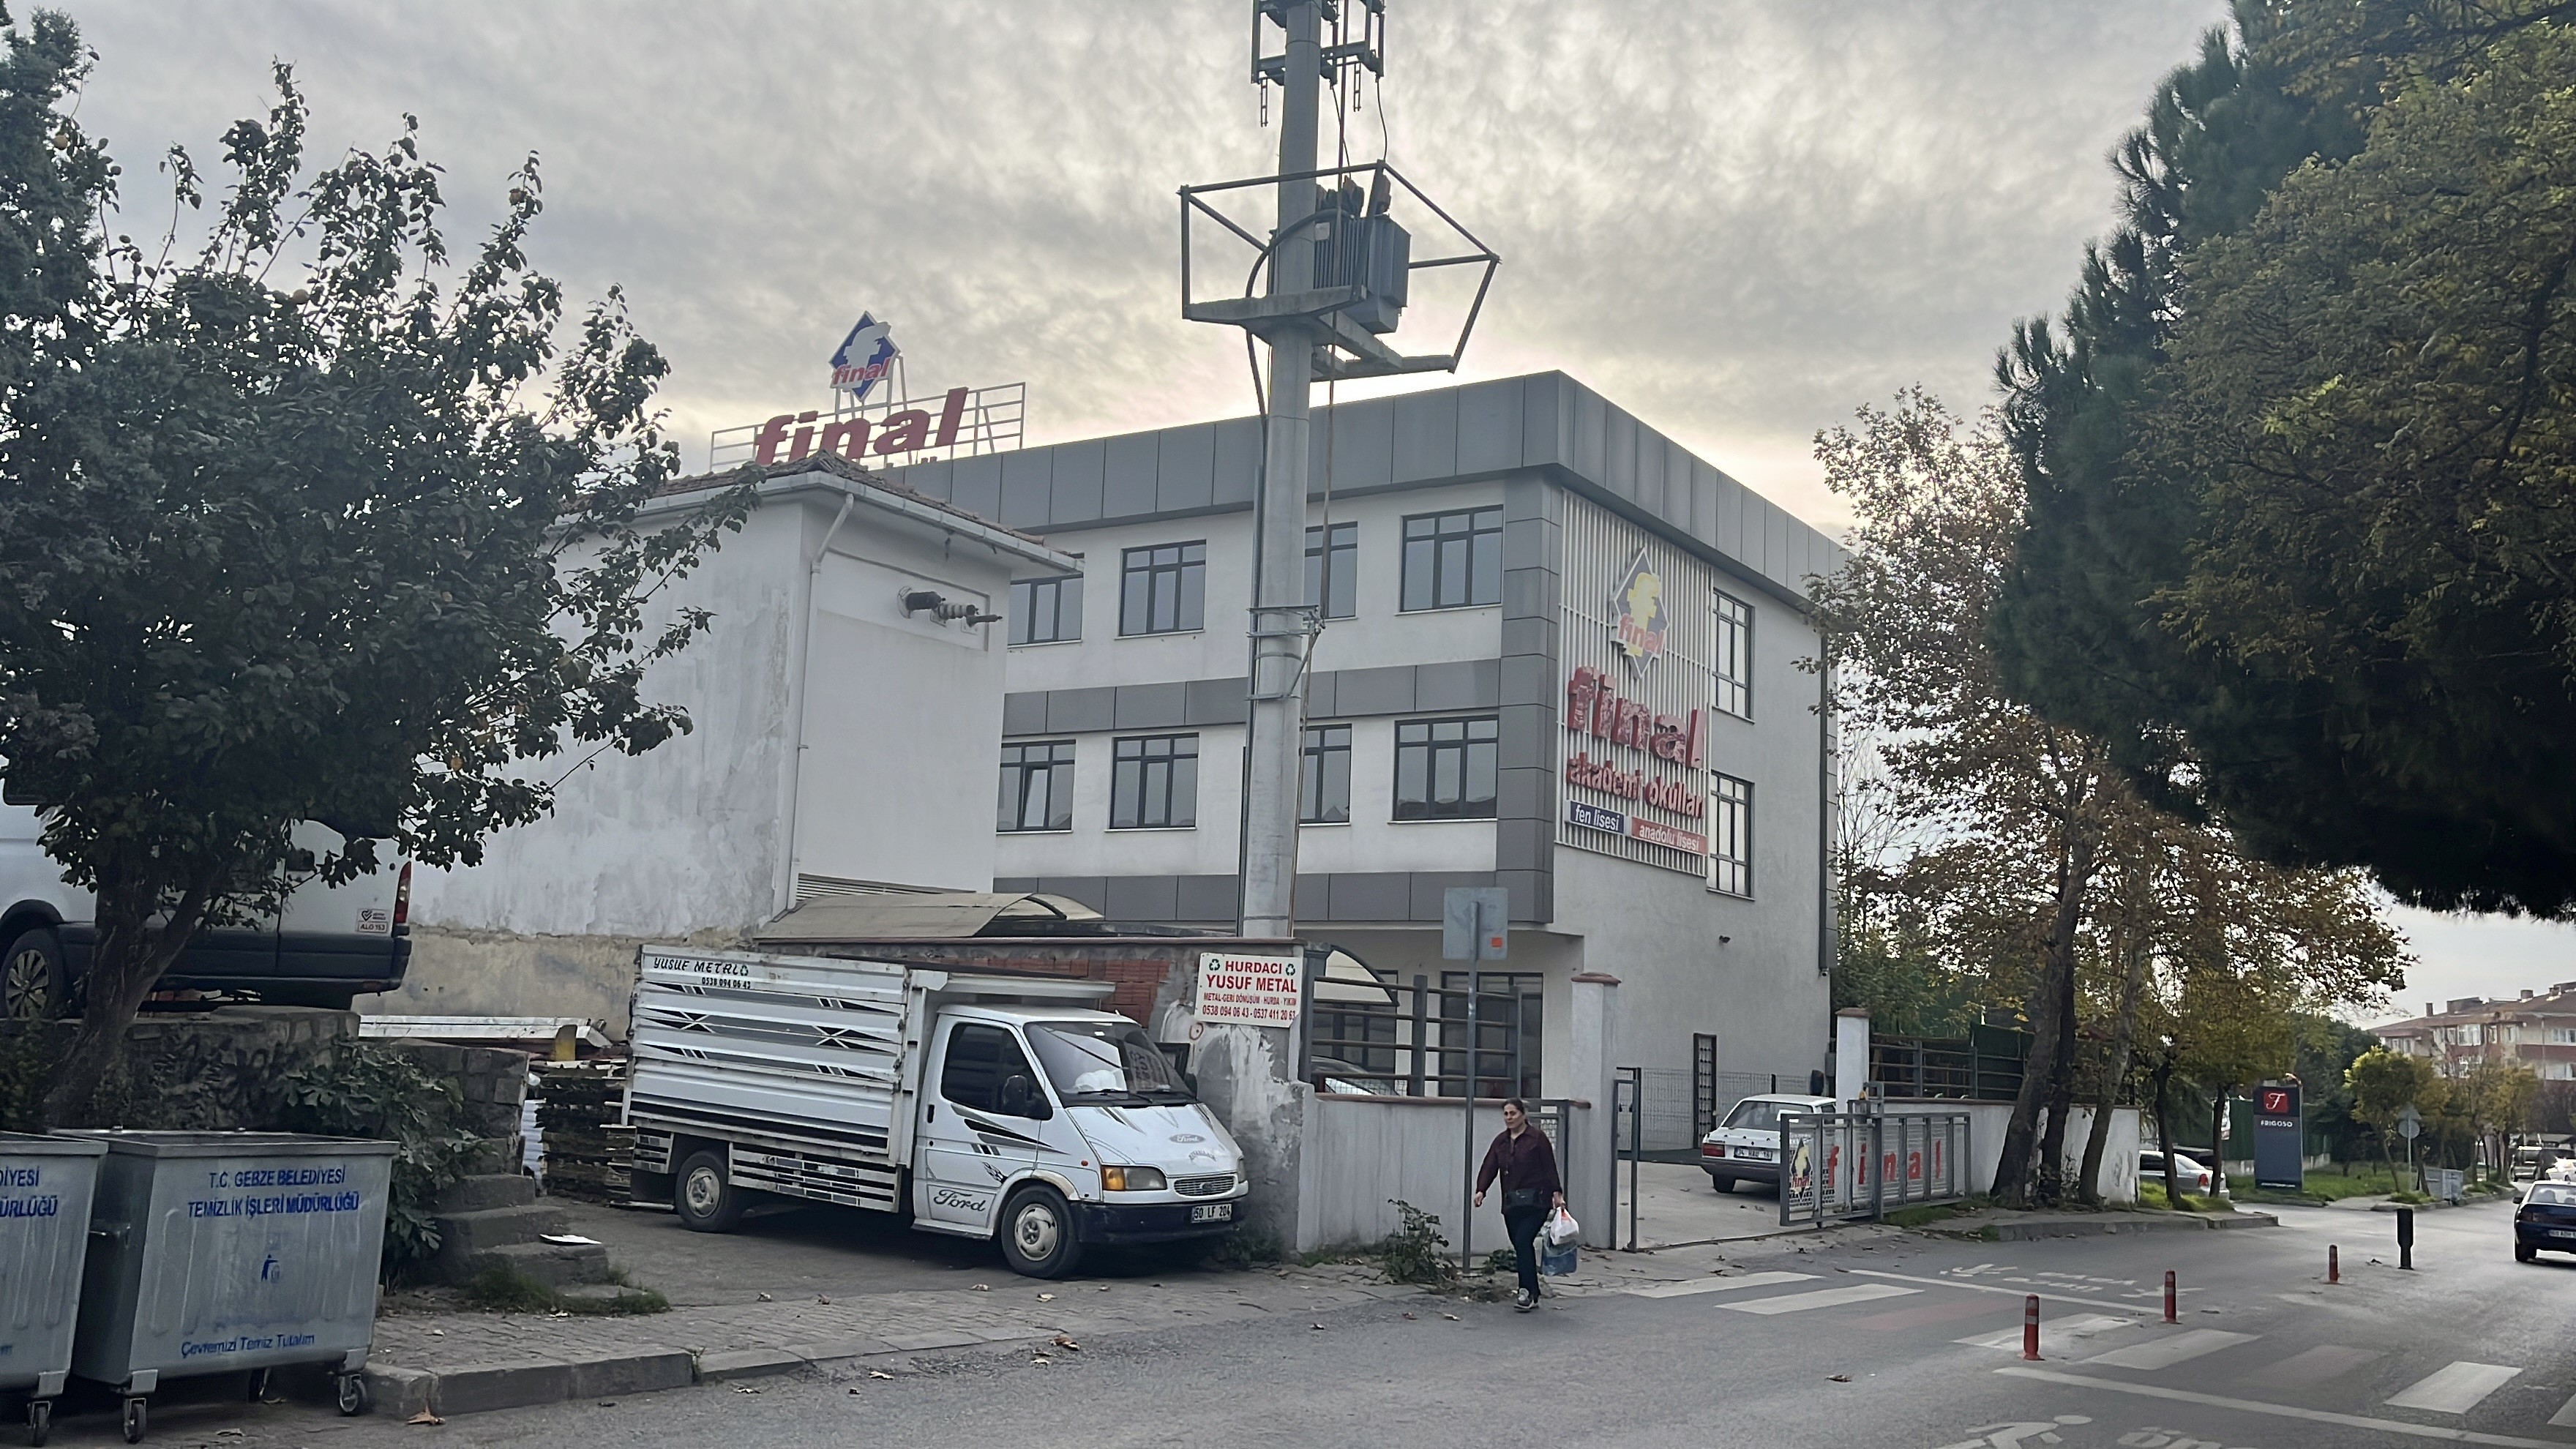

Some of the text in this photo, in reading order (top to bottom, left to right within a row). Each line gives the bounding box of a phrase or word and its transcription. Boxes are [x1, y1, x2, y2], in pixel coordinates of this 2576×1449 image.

[832, 357, 891, 385] final
[755, 386, 969, 465] final
[1618, 613, 1665, 655] final
[1568, 666, 1707, 768] final
[1566, 752, 1643, 800] akademi
[1576, 805, 1620, 831] fen lisesi
[1639, 824, 1699, 852] anadolu lisesi
[654, 957, 689, 970] YUSUF
[1225, 961, 1282, 974] HURDACI
[702, 977, 750, 989] 0538 094 06 43
[1207, 974, 1297, 992] YUSUF METAL
[1202, 1005, 1218, 1015] 0538
[1220, 1006, 1231, 1016] 094
[1233, 1007, 1240, 1016] 06
[1242, 1008, 1248, 1017] 43
[1253, 1008, 1268, 1019] 0537
[1269, 1008, 1278, 1019] 411
[235, 1170, 274, 1187] GEBZE
[277, 1164, 345, 1186] BELEDİYESİ
[187, 1191, 360, 1220] TEMİZLİK İŞLERİ MÜDÜRLÜĞÜ
[934, 1189, 986, 1211] Ford
[240, 1336, 273, 1351] Temiz
